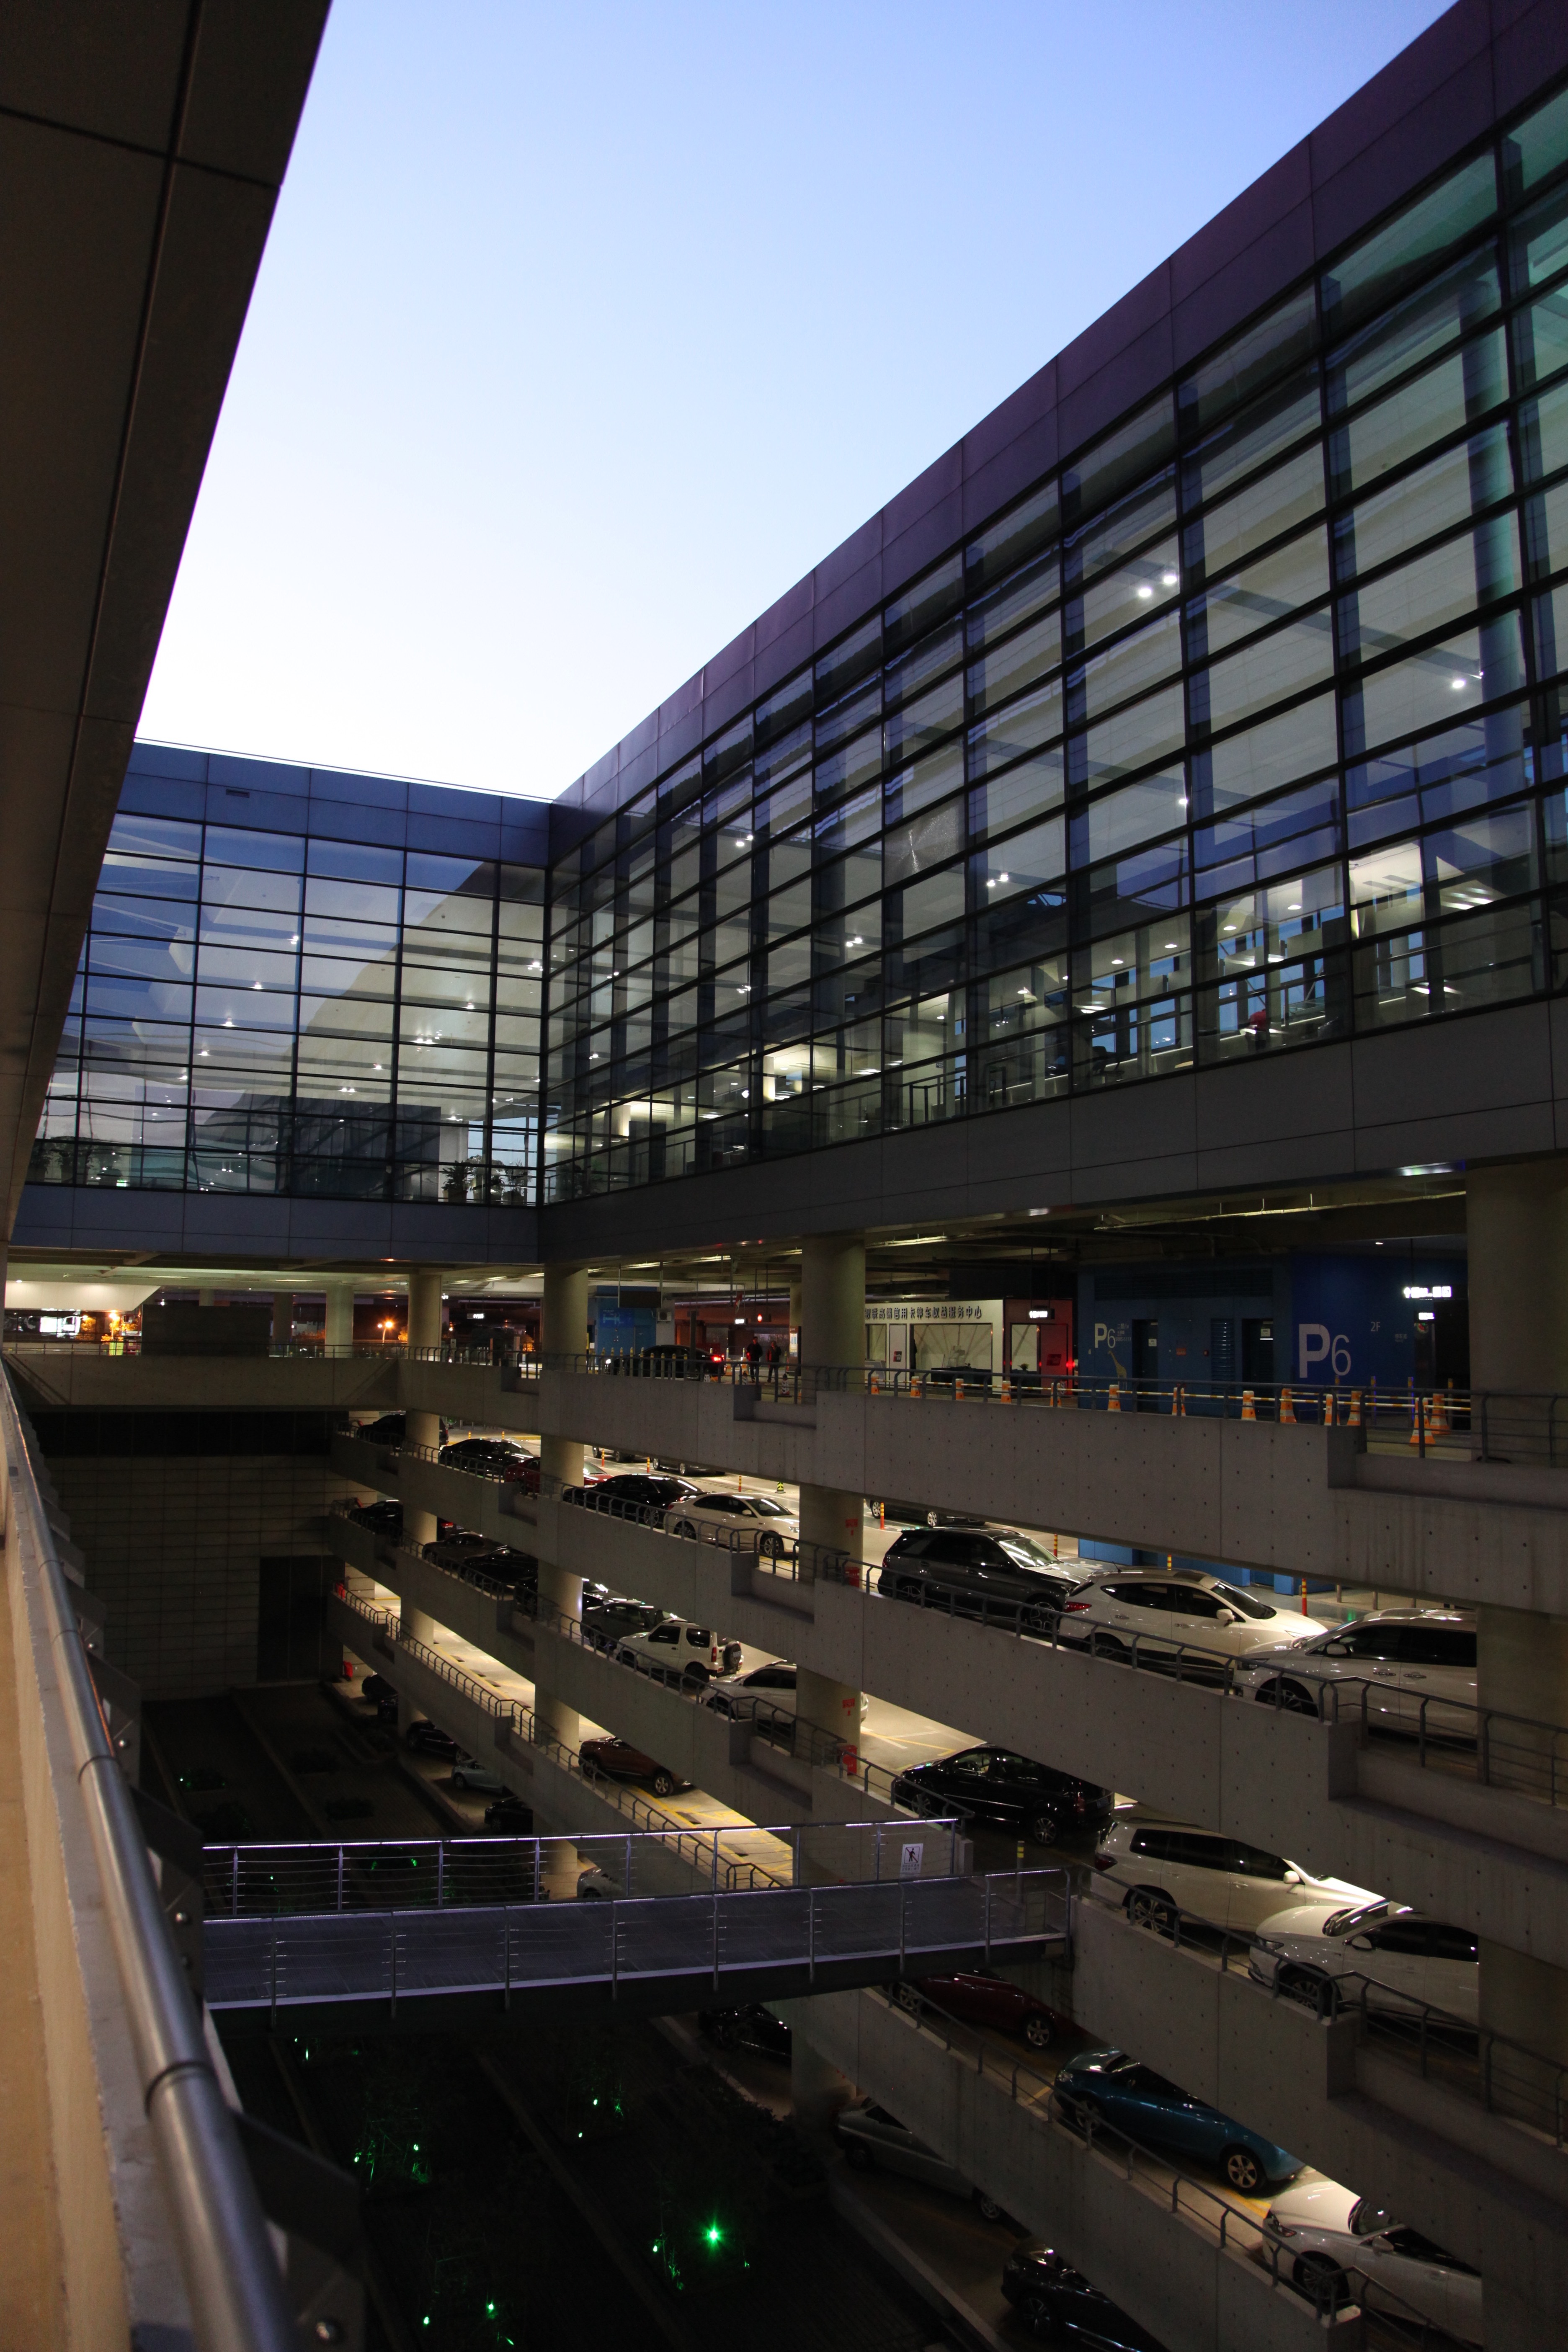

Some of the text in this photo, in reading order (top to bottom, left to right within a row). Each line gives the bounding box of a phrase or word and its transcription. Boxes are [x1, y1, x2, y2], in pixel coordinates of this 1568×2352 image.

[1094, 1323, 1116, 1349] P6
[1370, 1321, 1381, 1332] 2F
[1298, 1323, 1352, 1378] P6
